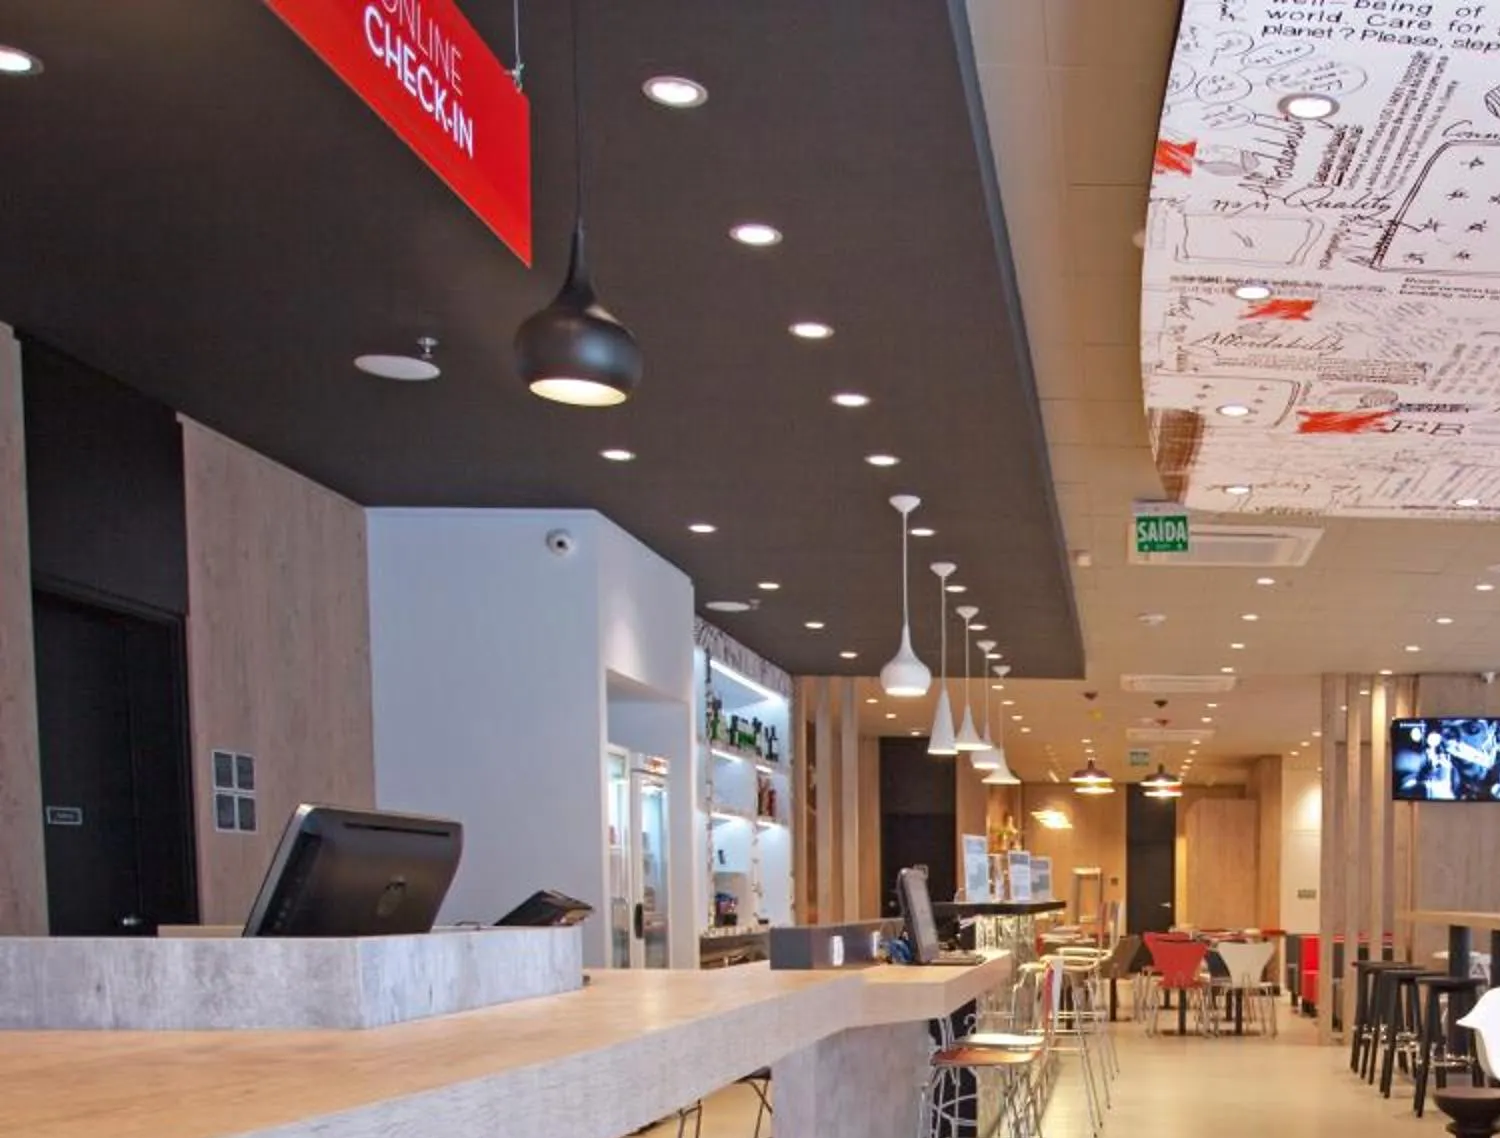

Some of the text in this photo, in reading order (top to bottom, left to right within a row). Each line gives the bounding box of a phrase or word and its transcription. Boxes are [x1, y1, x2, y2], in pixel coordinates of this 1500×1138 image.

[1455, 6, 1485, 18] of
[1367, 13, 1432, 30] Care
[1449, 20, 1485, 34] for
[1451, 37, 1500, 53] step
[1137, 518, 1188, 543] SAÍDA
